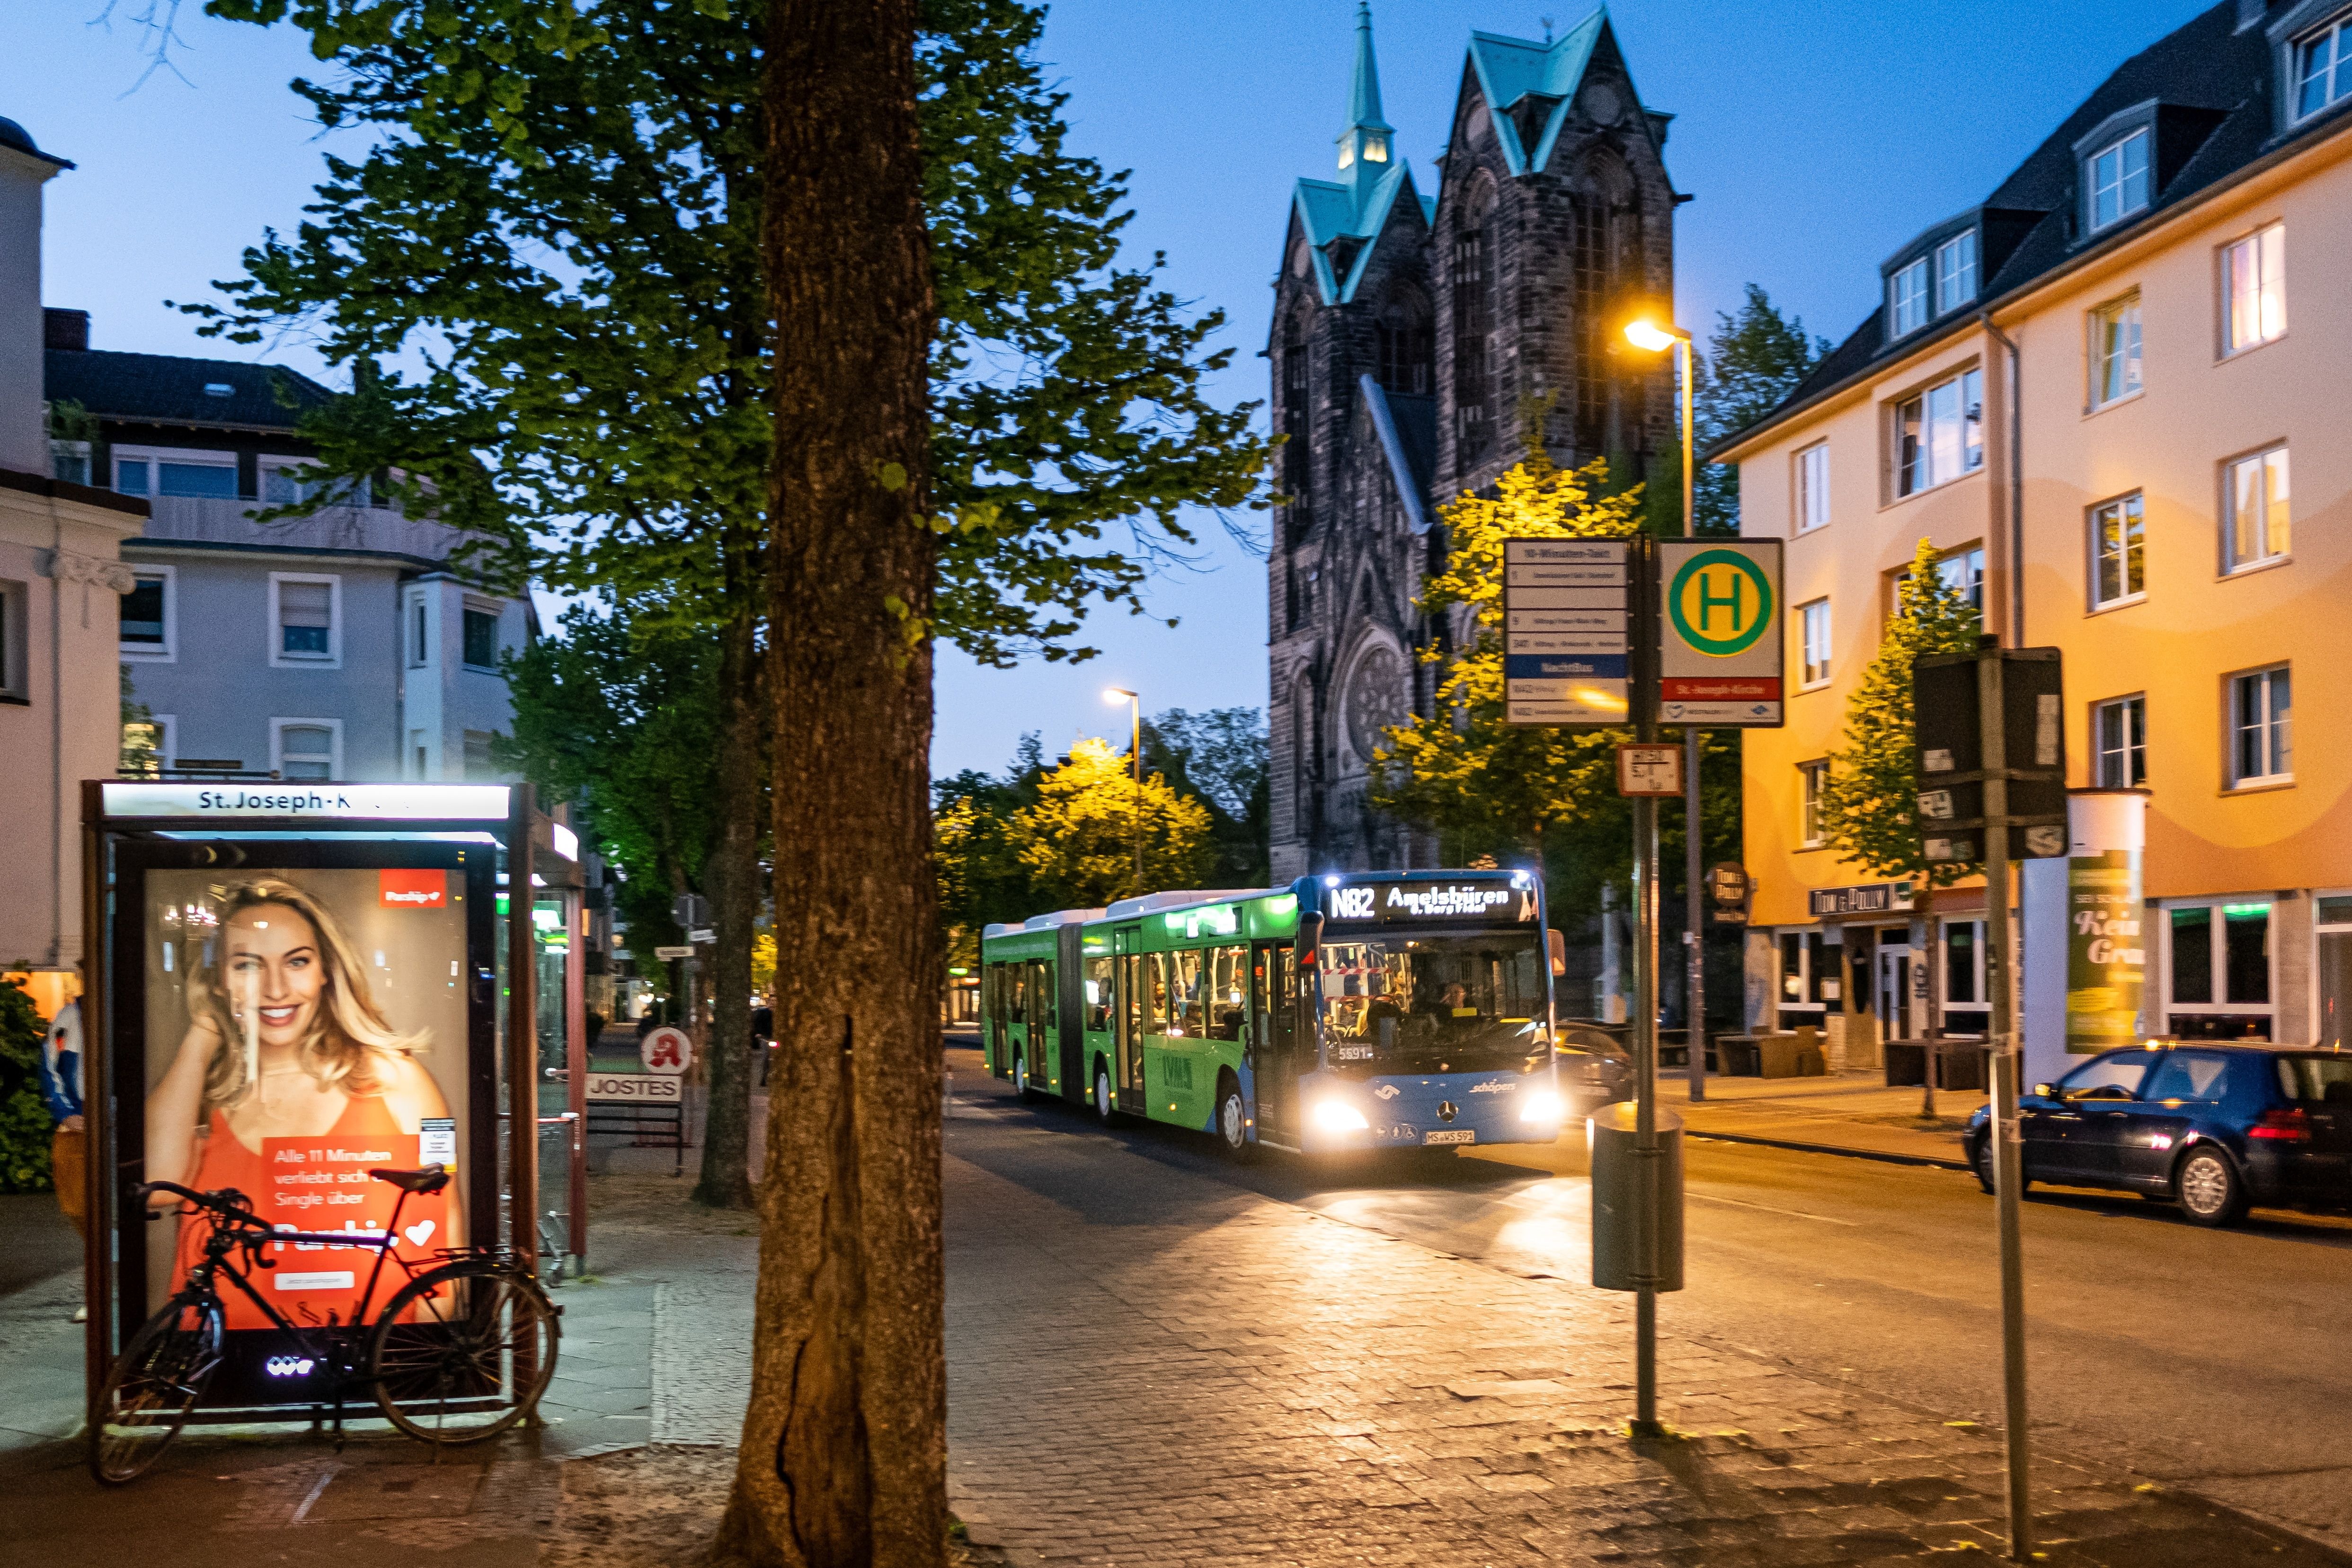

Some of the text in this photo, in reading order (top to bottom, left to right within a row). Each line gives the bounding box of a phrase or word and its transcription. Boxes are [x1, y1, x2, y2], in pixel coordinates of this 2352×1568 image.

[1700, 573, 1741, 631] H
[1331, 886, 1509, 918] N82 Amelsbüren
[1339, 1047, 1366, 1060] 5591
[591, 1080, 676, 1096] JOSTES
[1428, 1133, 1439, 1142] MS
[1457, 1132, 1473, 1141] 591
[274, 1149, 392, 1163] Alle 11 Minuten
[274, 1169, 334, 1184] verliebt
[337, 1169, 369, 1183] sich
[274, 1191, 365, 1209] Single über
